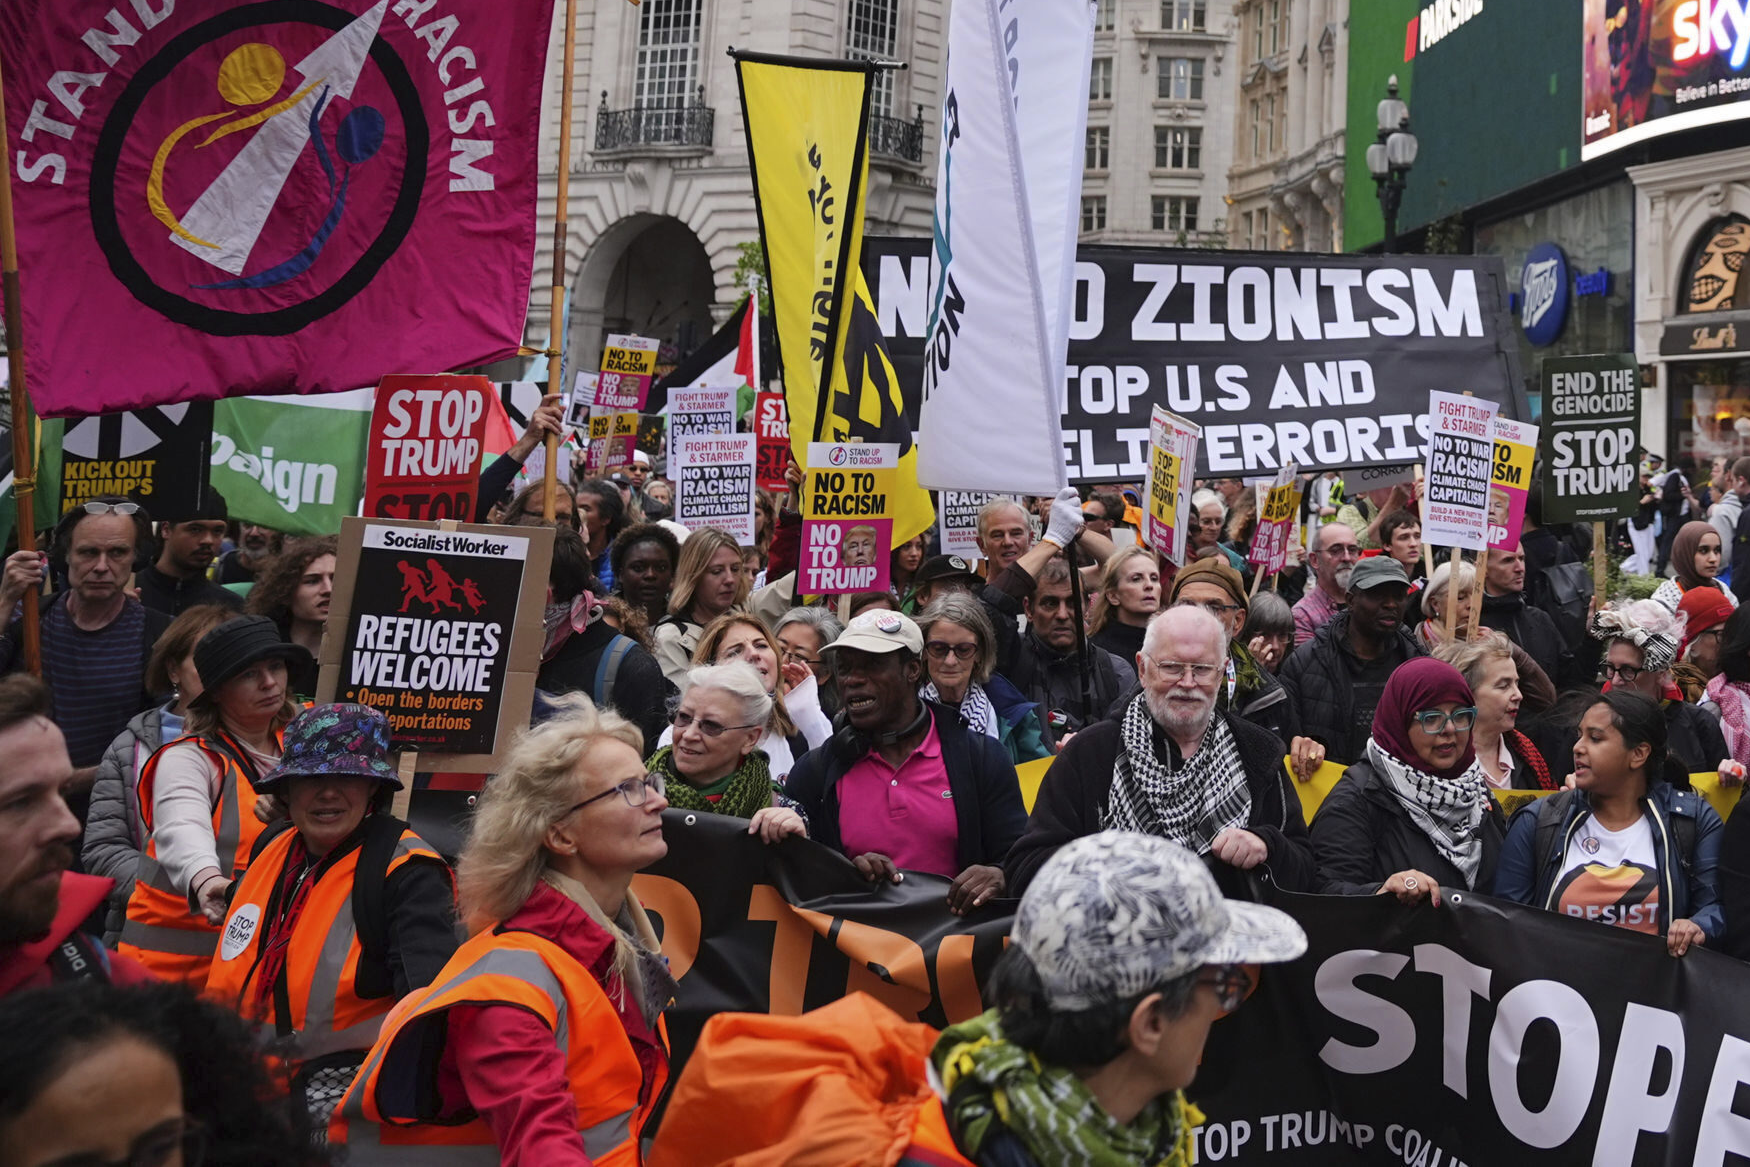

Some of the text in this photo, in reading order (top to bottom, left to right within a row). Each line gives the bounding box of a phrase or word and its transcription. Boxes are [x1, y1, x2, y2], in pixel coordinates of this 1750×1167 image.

[1130, 262, 1485, 341] ZIONISM
[608, 349, 642, 362] NO TO
[606, 360, 648, 373] RACISM
[602, 373, 620, 384] NO
[1166, 359, 1376, 413] U.S AND
[1552, 369, 1635, 396] END THE
[601, 383, 617, 394] TO
[675, 392, 729, 402] FIGHT TRUMP
[599, 393, 639, 407] TRUMP
[687, 402, 725, 410] STARMER
[1552, 392, 1635, 416] GENOCIDE
[382, 389, 483, 439] STOP
[672, 413, 732, 424] NO TO WAR
[1438, 401, 1491, 421] FIGHT TRUMP
[672, 423, 731, 436] RACISM
[1442, 418, 1449, 430] &
[1452, 419, 1487, 437] STARMER
[685, 440, 748, 452] FIGHT TRUMP
[850, 448, 880, 456] STAND UP
[1434, 436, 1490, 458] NO TO WAR
[1552, 427, 1635, 468] STOP
[381, 438, 479, 477] TRUMP
[689, 452, 745, 463] & STARMER
[850, 457, 882, 465] TO RACISM
[1433, 453, 1488, 481] RACISM
[65, 460, 156, 479] KICK OUT
[682, 466, 750, 480] NO TO WAR
[63, 477, 153, 498] TRUMP'S
[682, 479, 750, 496] RACISM
[814, 472, 875, 494] NO TO
[1431, 474, 1486, 492] CLIMATE CHAOS
[1552, 463, 1635, 497] TRUMP
[682, 494, 748, 505] CLIMATE CHAOS
[812, 494, 886, 516] RACISM
[1431, 487, 1485, 507] CAPITALISM
[682, 504, 748, 517] CAPITALISM
[810, 524, 842, 546] NO
[808, 546, 838, 568] TO
[807, 567, 878, 590] TRUMP
[355, 614, 502, 657] REFUGEES
[351, 650, 495, 693] WELCOME
[357, 687, 484, 711] Open the borders
[233, 915, 255, 931] STOP
[226, 925, 250, 943] TRUMP
[1260, 1109, 1375, 1152] TRUMP
